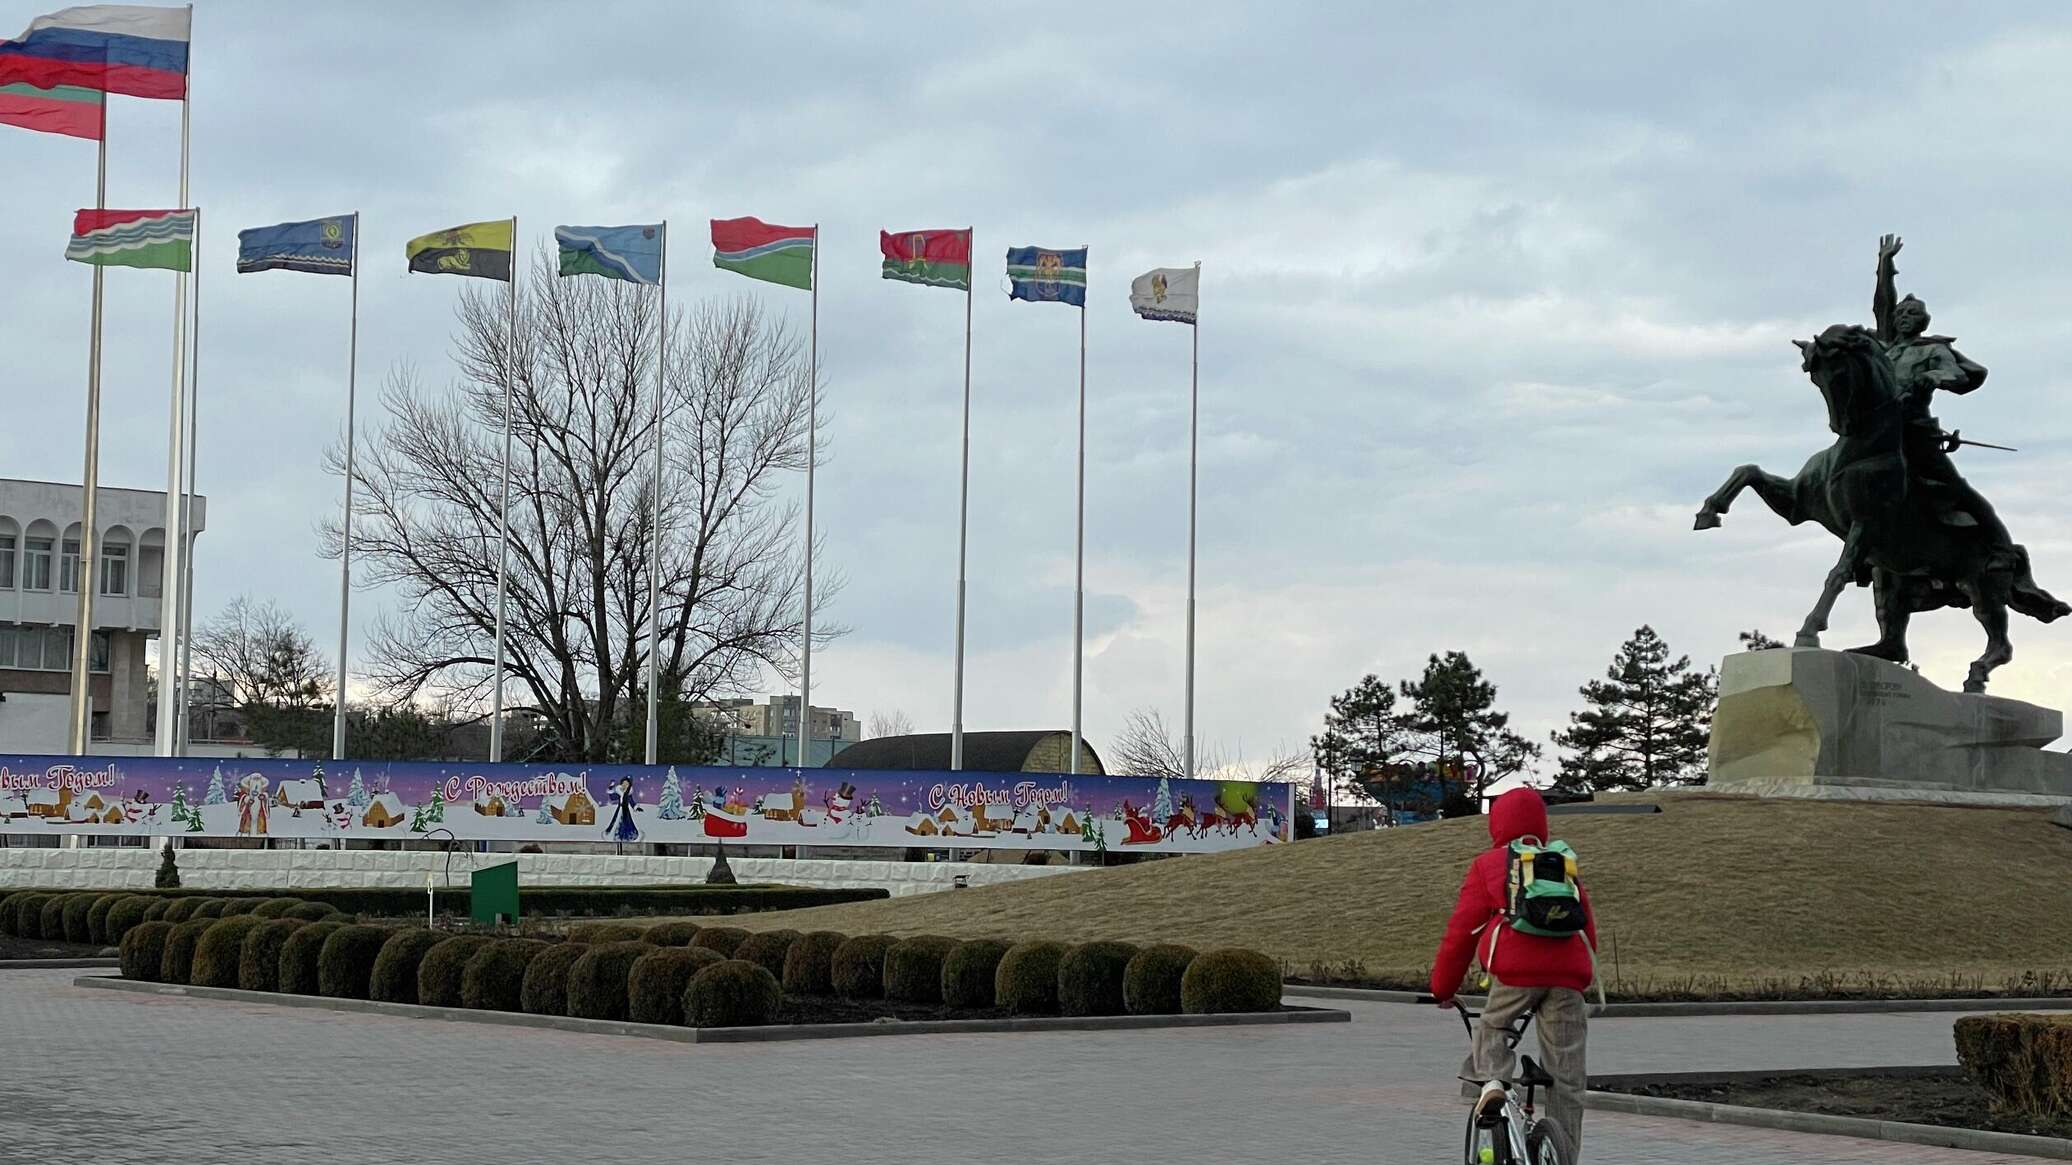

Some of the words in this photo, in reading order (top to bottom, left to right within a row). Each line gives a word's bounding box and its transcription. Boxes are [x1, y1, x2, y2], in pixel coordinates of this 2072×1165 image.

[46, 763, 115, 795] Годом!
[445, 776, 461, 801] С
[465, 771, 587, 803] Рождеством!
[929, 784, 945, 809] С
[949, 782, 1010, 809] Новым
[1014, 781, 1068, 809] Годом!
